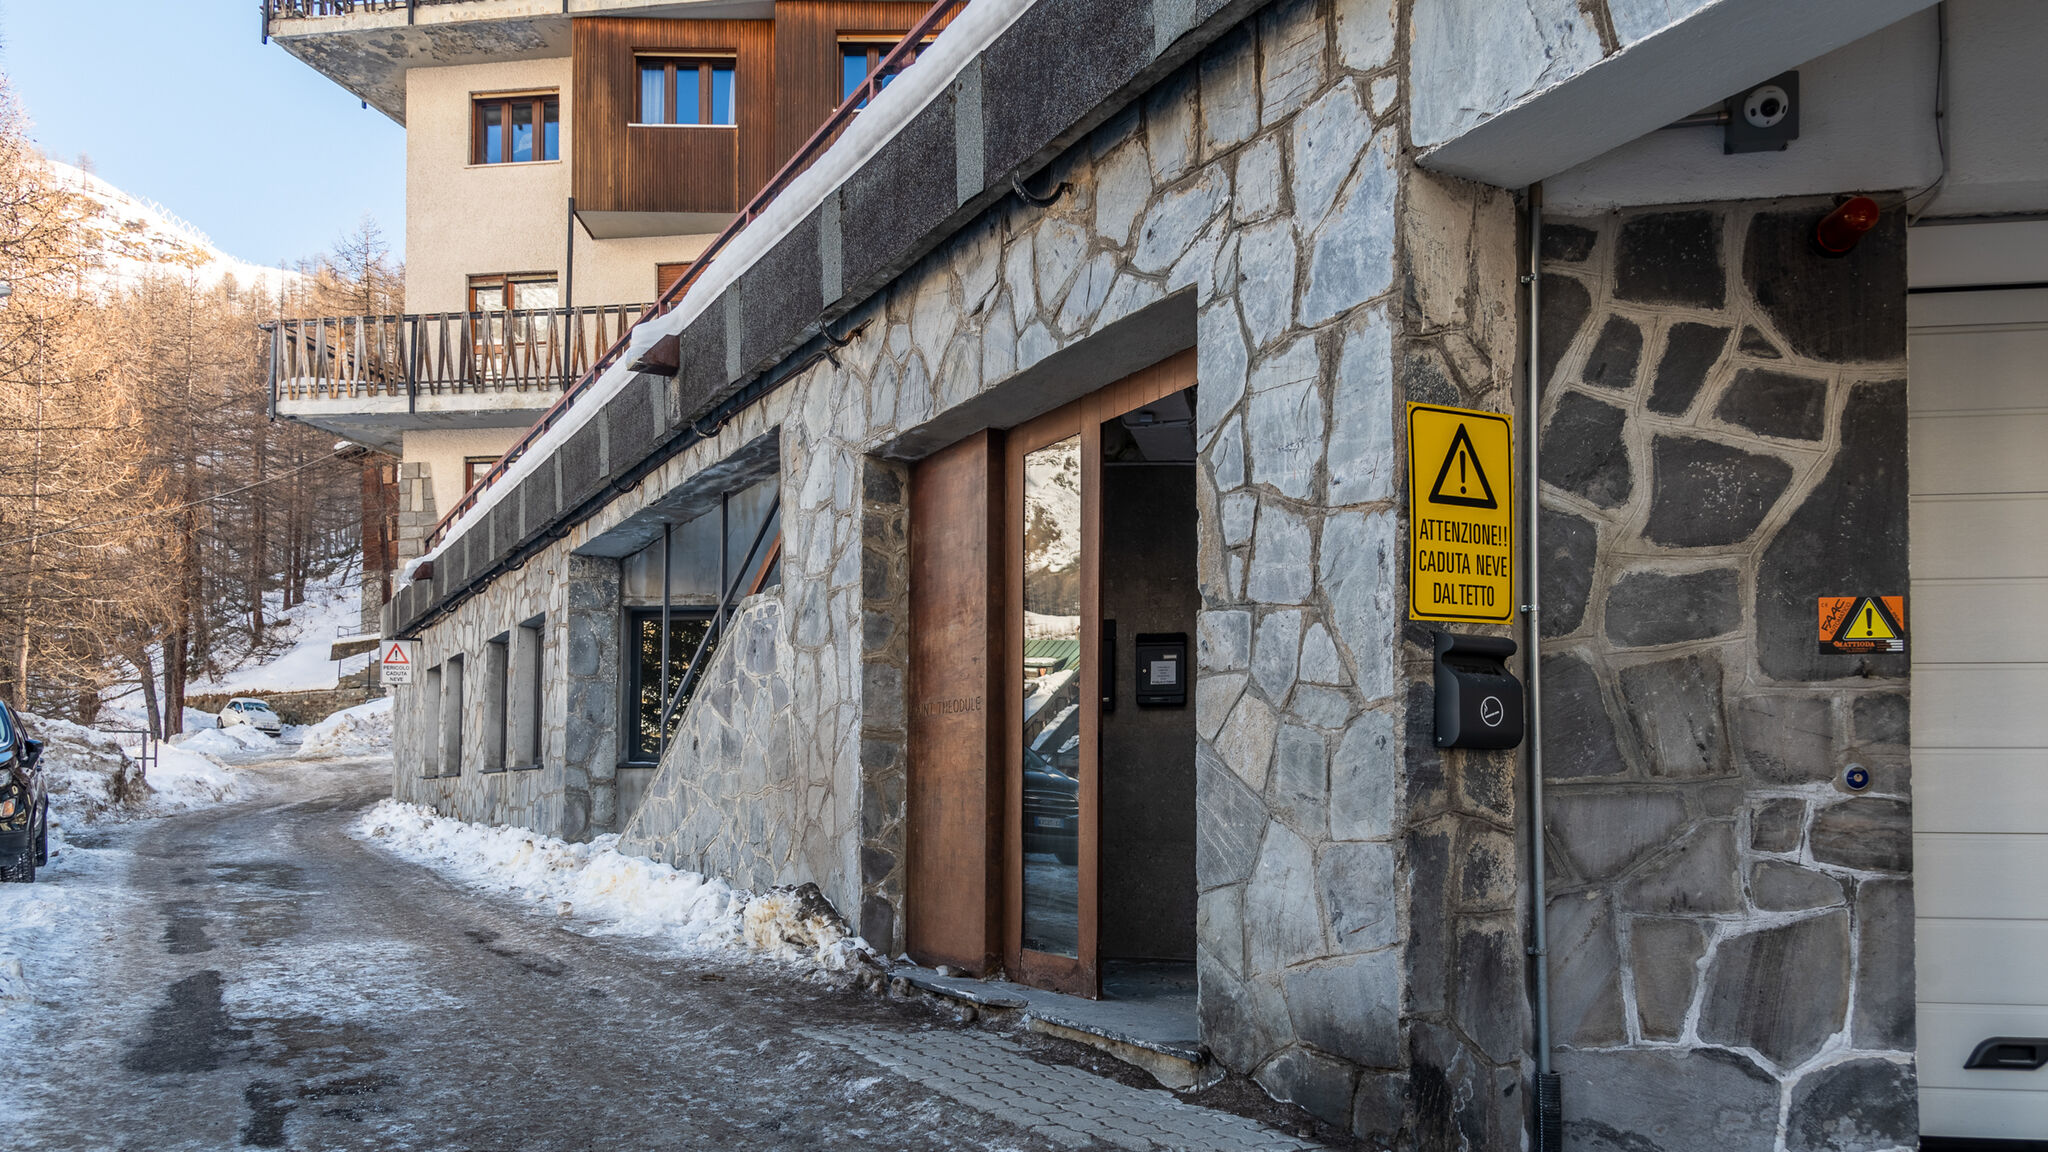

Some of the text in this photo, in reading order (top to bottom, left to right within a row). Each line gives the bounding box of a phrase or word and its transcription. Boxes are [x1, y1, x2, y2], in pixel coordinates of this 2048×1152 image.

[1419, 518, 1507, 547] ATTENZIONE!!
[1419, 550, 1507, 577] CADUTA NEVE
[1821, 598, 1845, 631] FAAC
[937, 696, 980, 714] THEODULE
